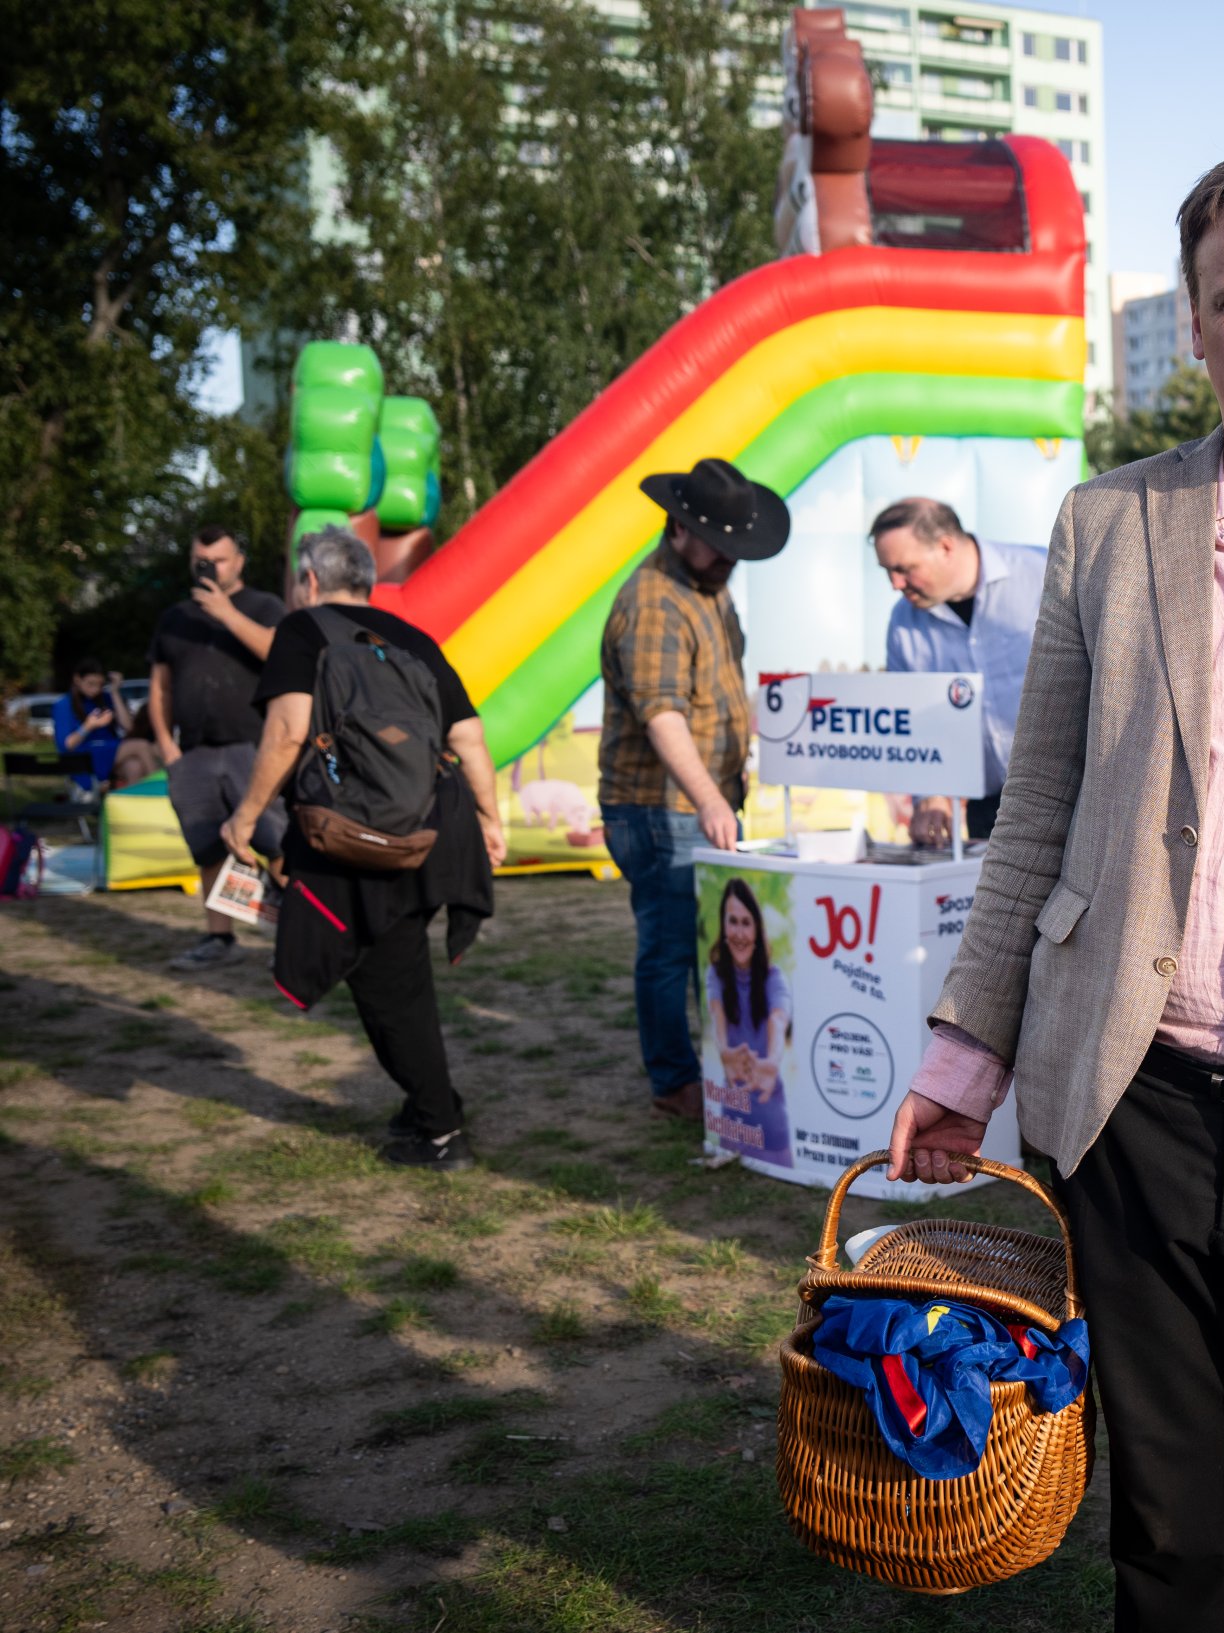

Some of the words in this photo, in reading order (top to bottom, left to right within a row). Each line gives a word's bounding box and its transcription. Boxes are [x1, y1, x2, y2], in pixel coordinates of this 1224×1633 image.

[766, 680, 782, 713] 6
[811, 707, 911, 736] PETICE
[787, 742, 804, 756] ZA
[809, 743, 882, 760] SVOBODU
[887, 748, 943, 763] SLOVA
